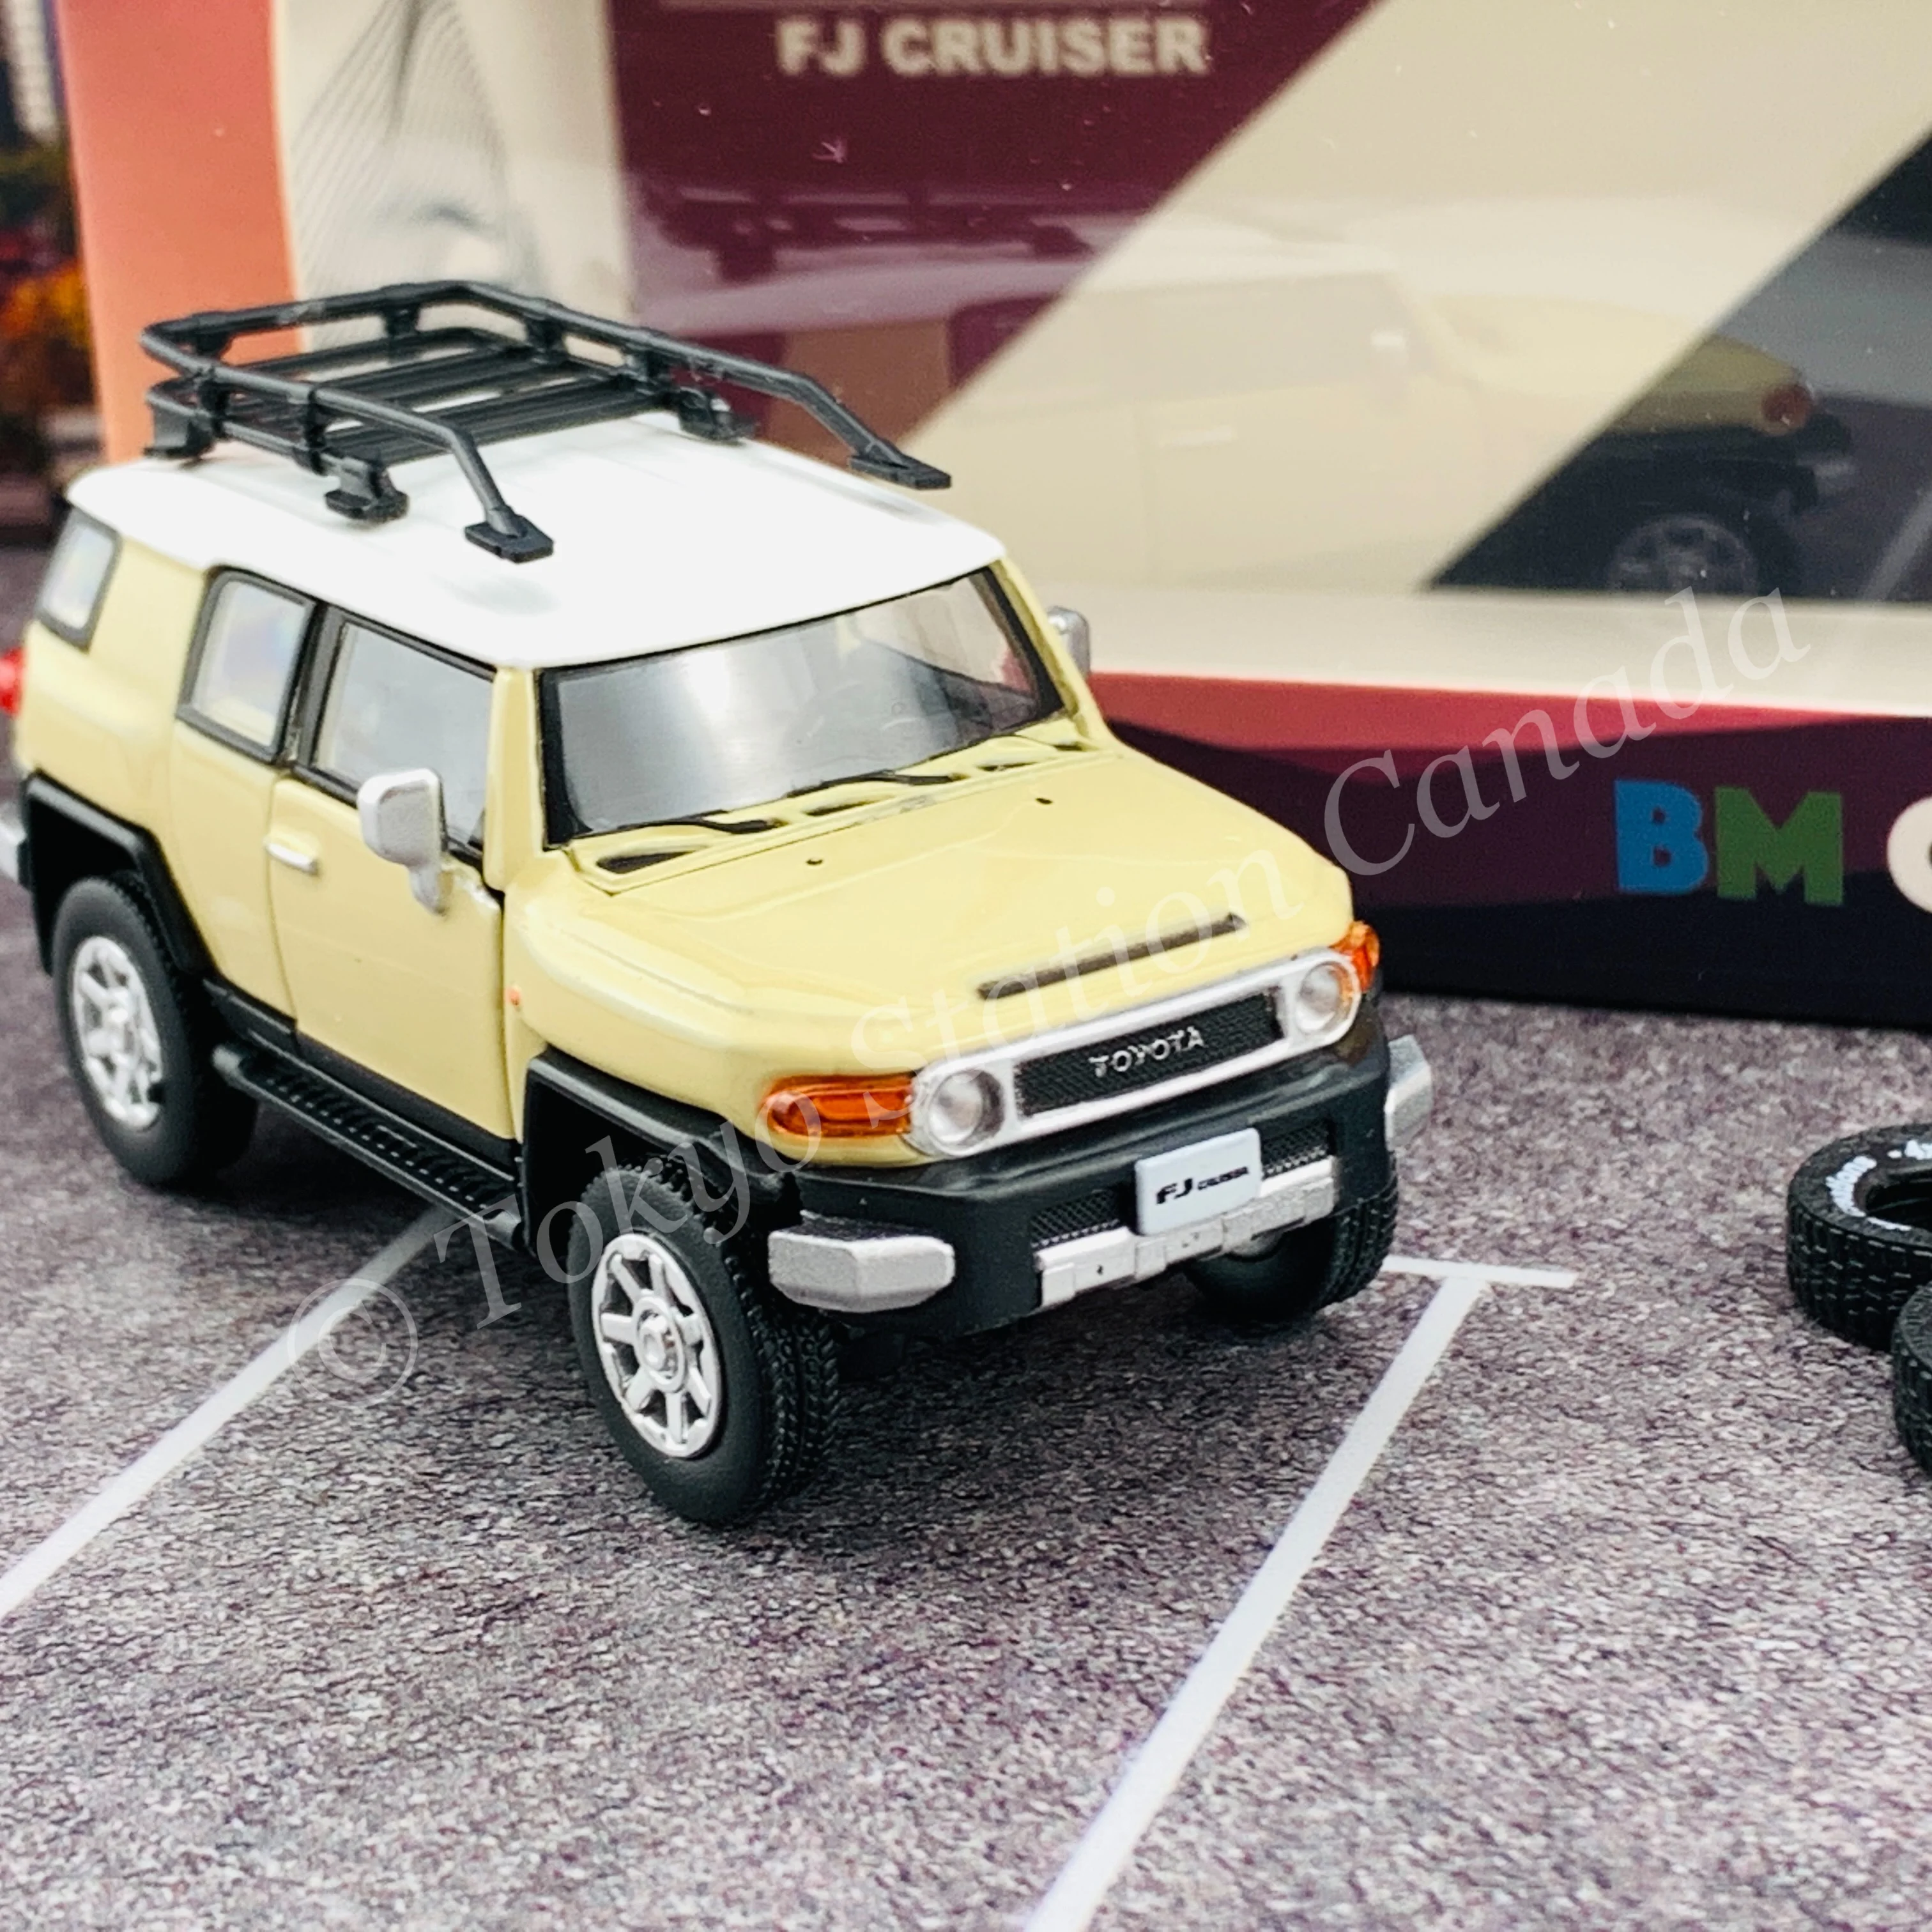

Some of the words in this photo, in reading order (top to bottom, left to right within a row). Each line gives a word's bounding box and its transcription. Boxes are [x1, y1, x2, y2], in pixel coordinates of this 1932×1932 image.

[776, 18, 865, 75] FJ
[882, 18, 1210, 76] CRUISER
[1614, 779, 1844, 907] BM
[1089, 1026, 1206, 1077] TOYOTA
[1156, 1177, 1193, 1204] FJ
